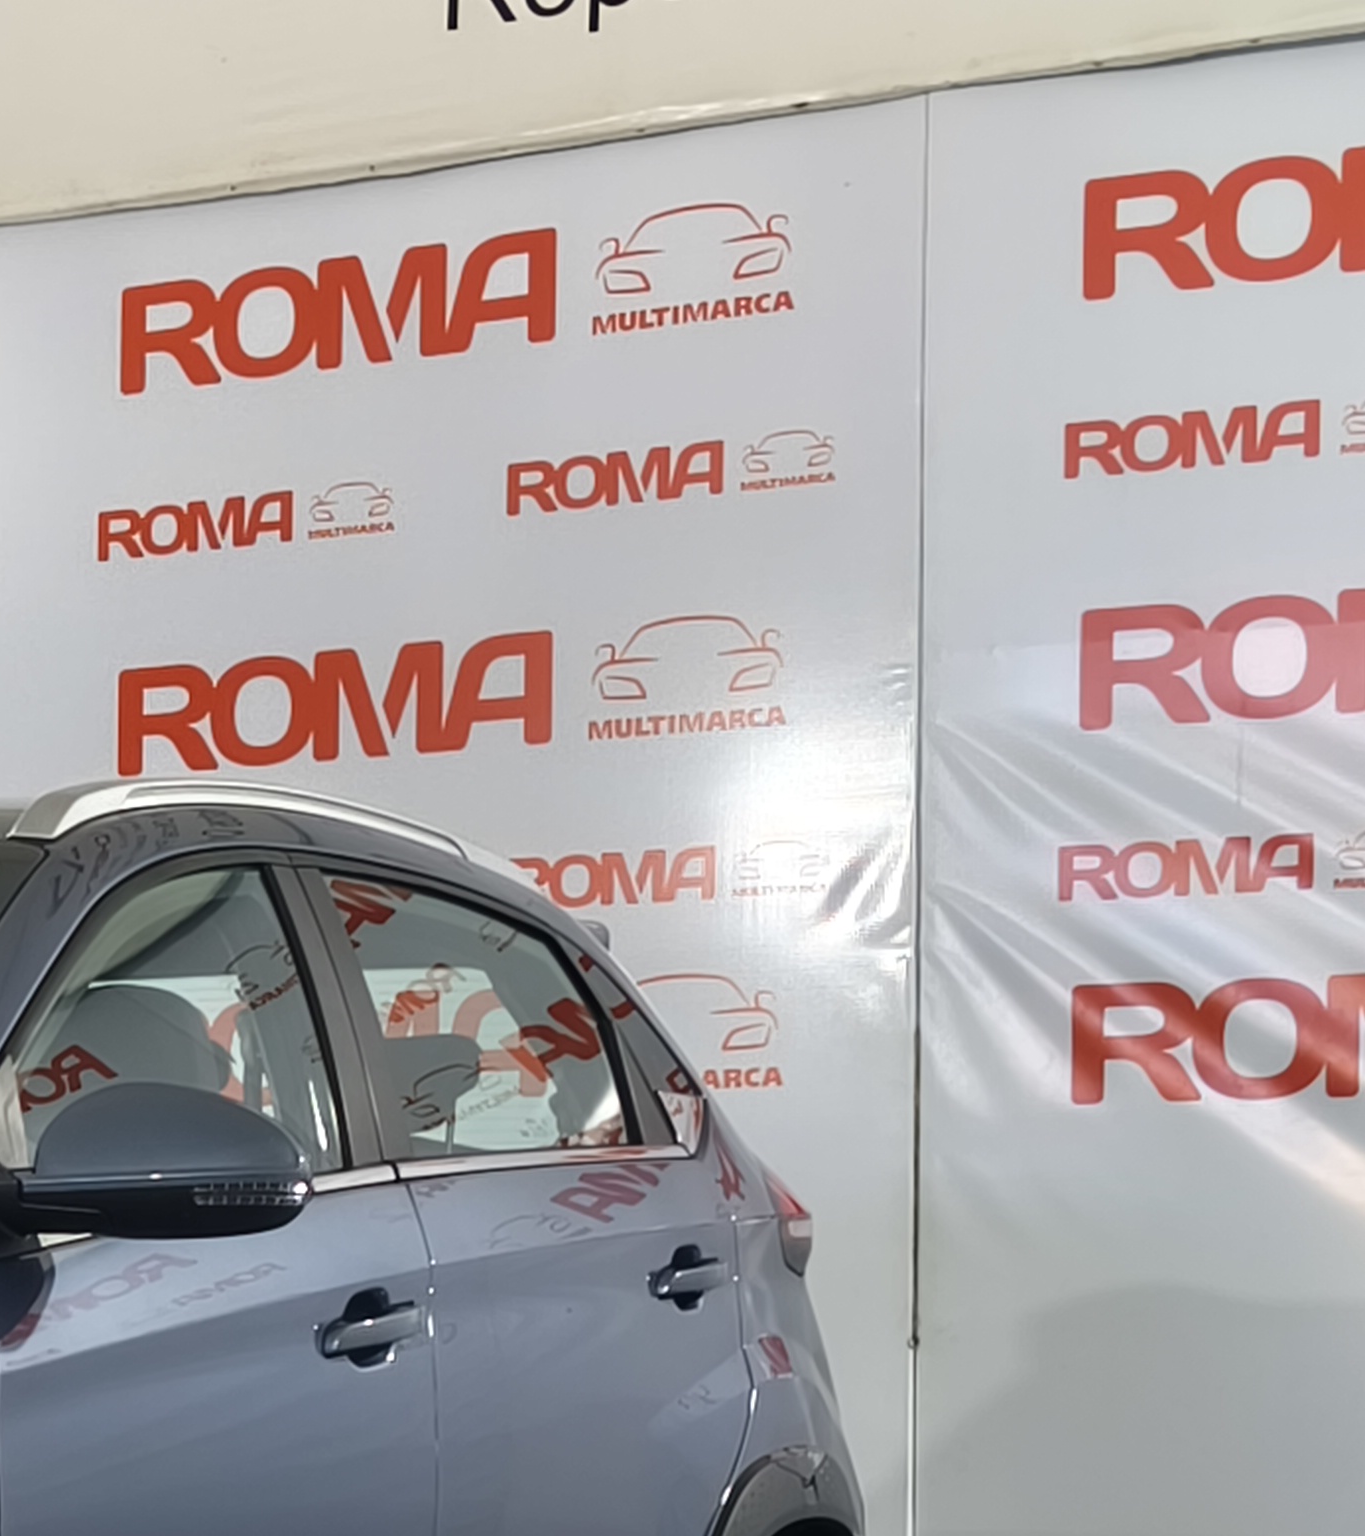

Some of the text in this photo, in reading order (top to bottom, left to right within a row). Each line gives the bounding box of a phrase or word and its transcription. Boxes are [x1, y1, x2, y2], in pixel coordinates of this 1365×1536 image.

[1082, 147, 1365, 301] RO
[119, 227, 557, 396] ROMA
[592, 292, 794, 336] MULTIMARCA
[506, 440, 724, 517] ROMA
[1064, 399, 1320, 480] ROMA
[97, 490, 294, 562] ROMA
[1080, 588, 1365, 730] RO
[117, 631, 553, 779] ROMA
[588, 705, 787, 741] MULTIMARCA
[1057, 834, 1314, 902] ROMA
[1071, 973, 1365, 1105] RO
